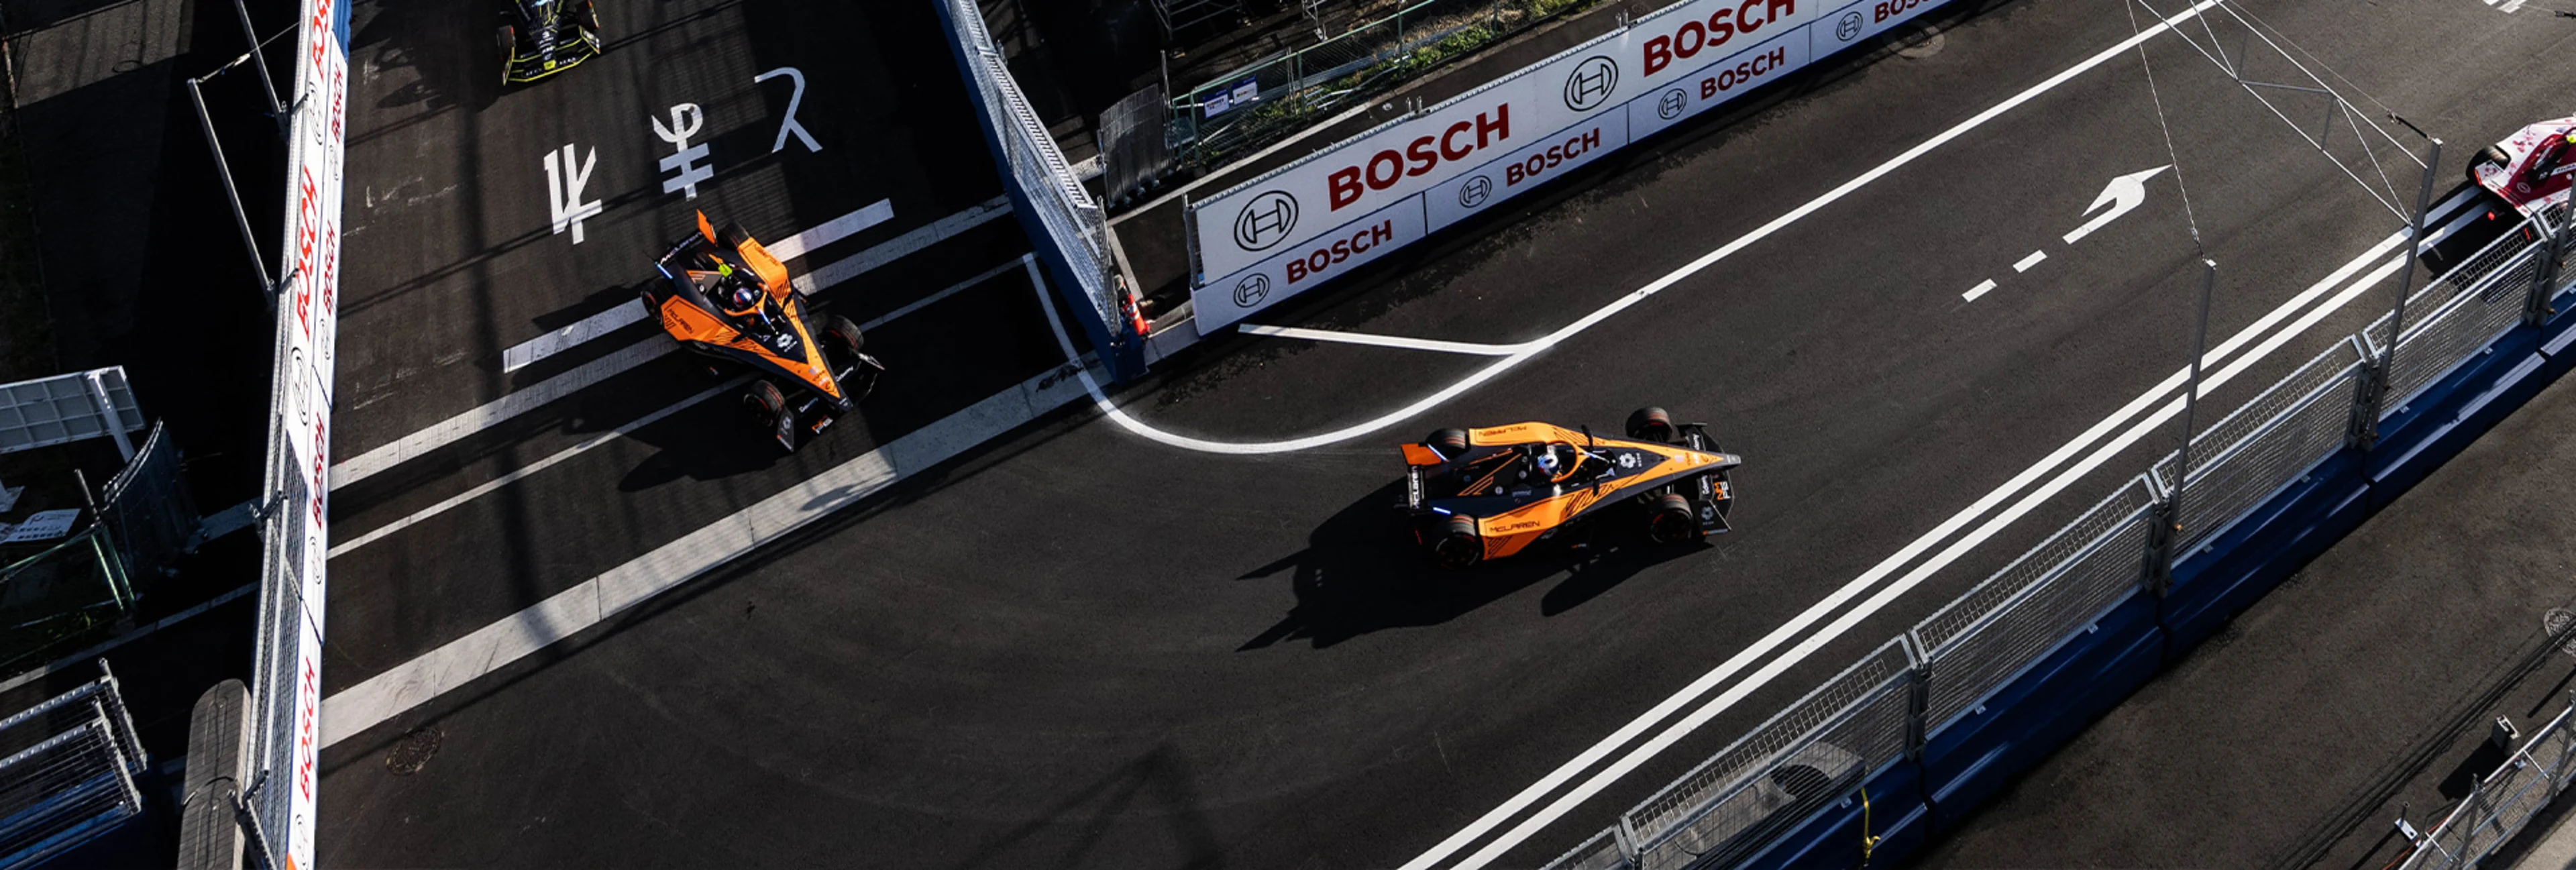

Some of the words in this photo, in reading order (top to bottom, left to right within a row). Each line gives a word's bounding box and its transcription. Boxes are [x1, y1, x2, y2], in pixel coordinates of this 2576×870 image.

[1644, 0, 1795, 78] BOSCH
[1700, 46, 1784, 101] BOSCH
[331, 62, 343, 144] BOSCH
[1328, 103, 1510, 212] BOSCH
[1506, 127, 1601, 186] BOSCH
[295, 164, 319, 342] BOSCH
[323, 219, 335, 317] BOSCH
[1287, 220, 1393, 284] BOSCH
[312, 411, 325, 530] BOSCH
[300, 656, 315, 804] BOSCH
